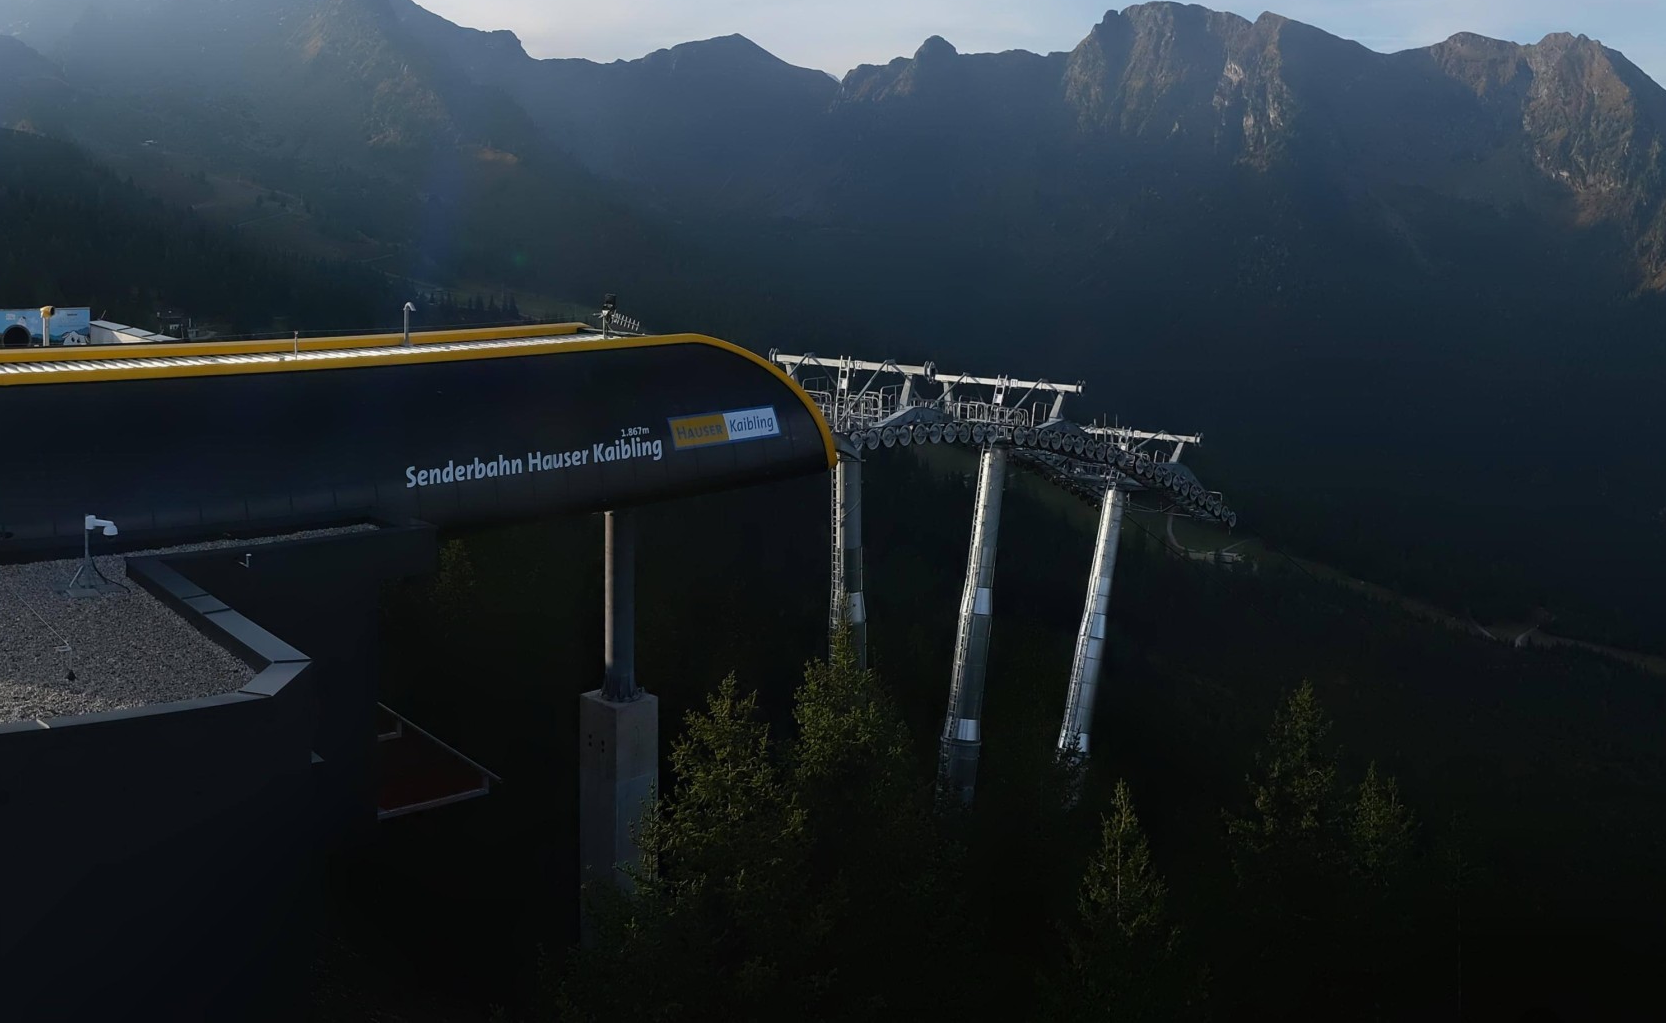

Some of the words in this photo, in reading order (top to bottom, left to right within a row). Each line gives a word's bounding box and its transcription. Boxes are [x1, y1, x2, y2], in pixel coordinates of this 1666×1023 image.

[621, 426, 650, 437] 1.867m
[729, 415, 774, 433] Kaibling
[405, 455, 523, 488] Senderbahn
[527, 448, 589, 473] Hauser
[592, 437, 663, 462] Kaibling
